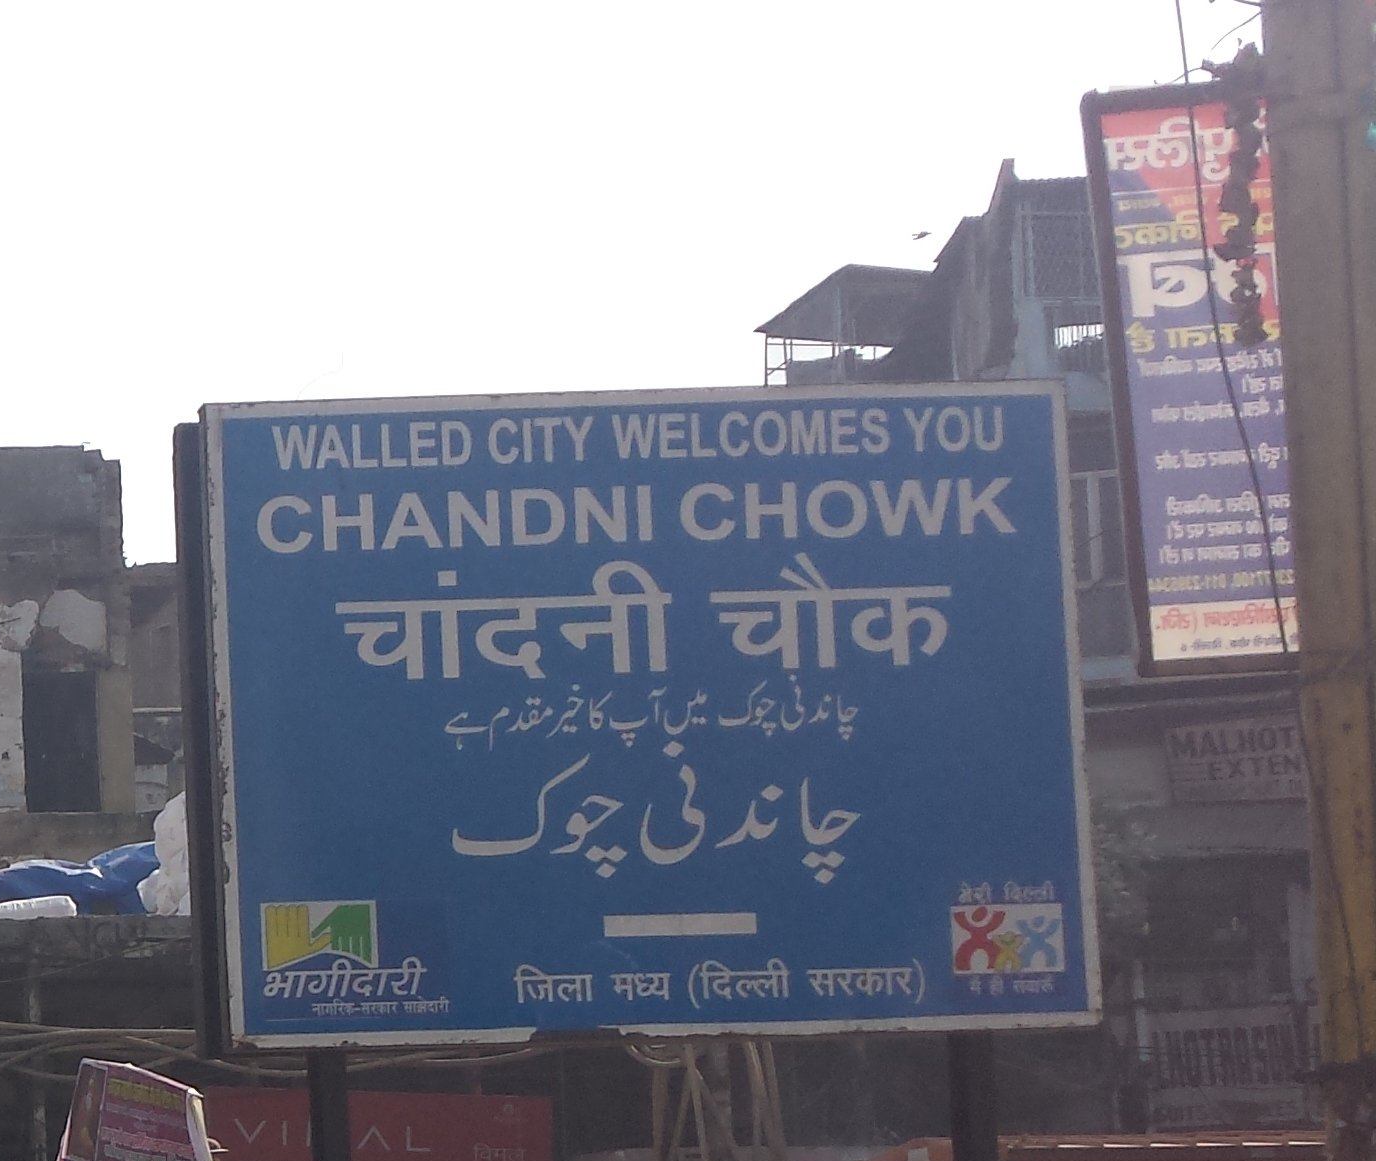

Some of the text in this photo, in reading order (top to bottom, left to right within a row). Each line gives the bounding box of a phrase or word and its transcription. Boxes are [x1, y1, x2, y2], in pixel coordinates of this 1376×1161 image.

[272, 405, 1003, 470] WALLED CITY WELCOMES YOU
[257, 476, 1017, 553] CHANDNI CHOWK
[335, 552, 951, 680] चांदनी चौक
[1169, 726, 1296, 758] MALHOT
[1208, 755, 1301, 780] EXTEN
[452, 741, 860, 884] چاندنی چوک
[263, 956, 428, 998] भागीदारी
[514, 958, 926, 1009] जिला मध्य (दिल्ली सरकार)
[234, 1118, 431, 1153] VIAL
